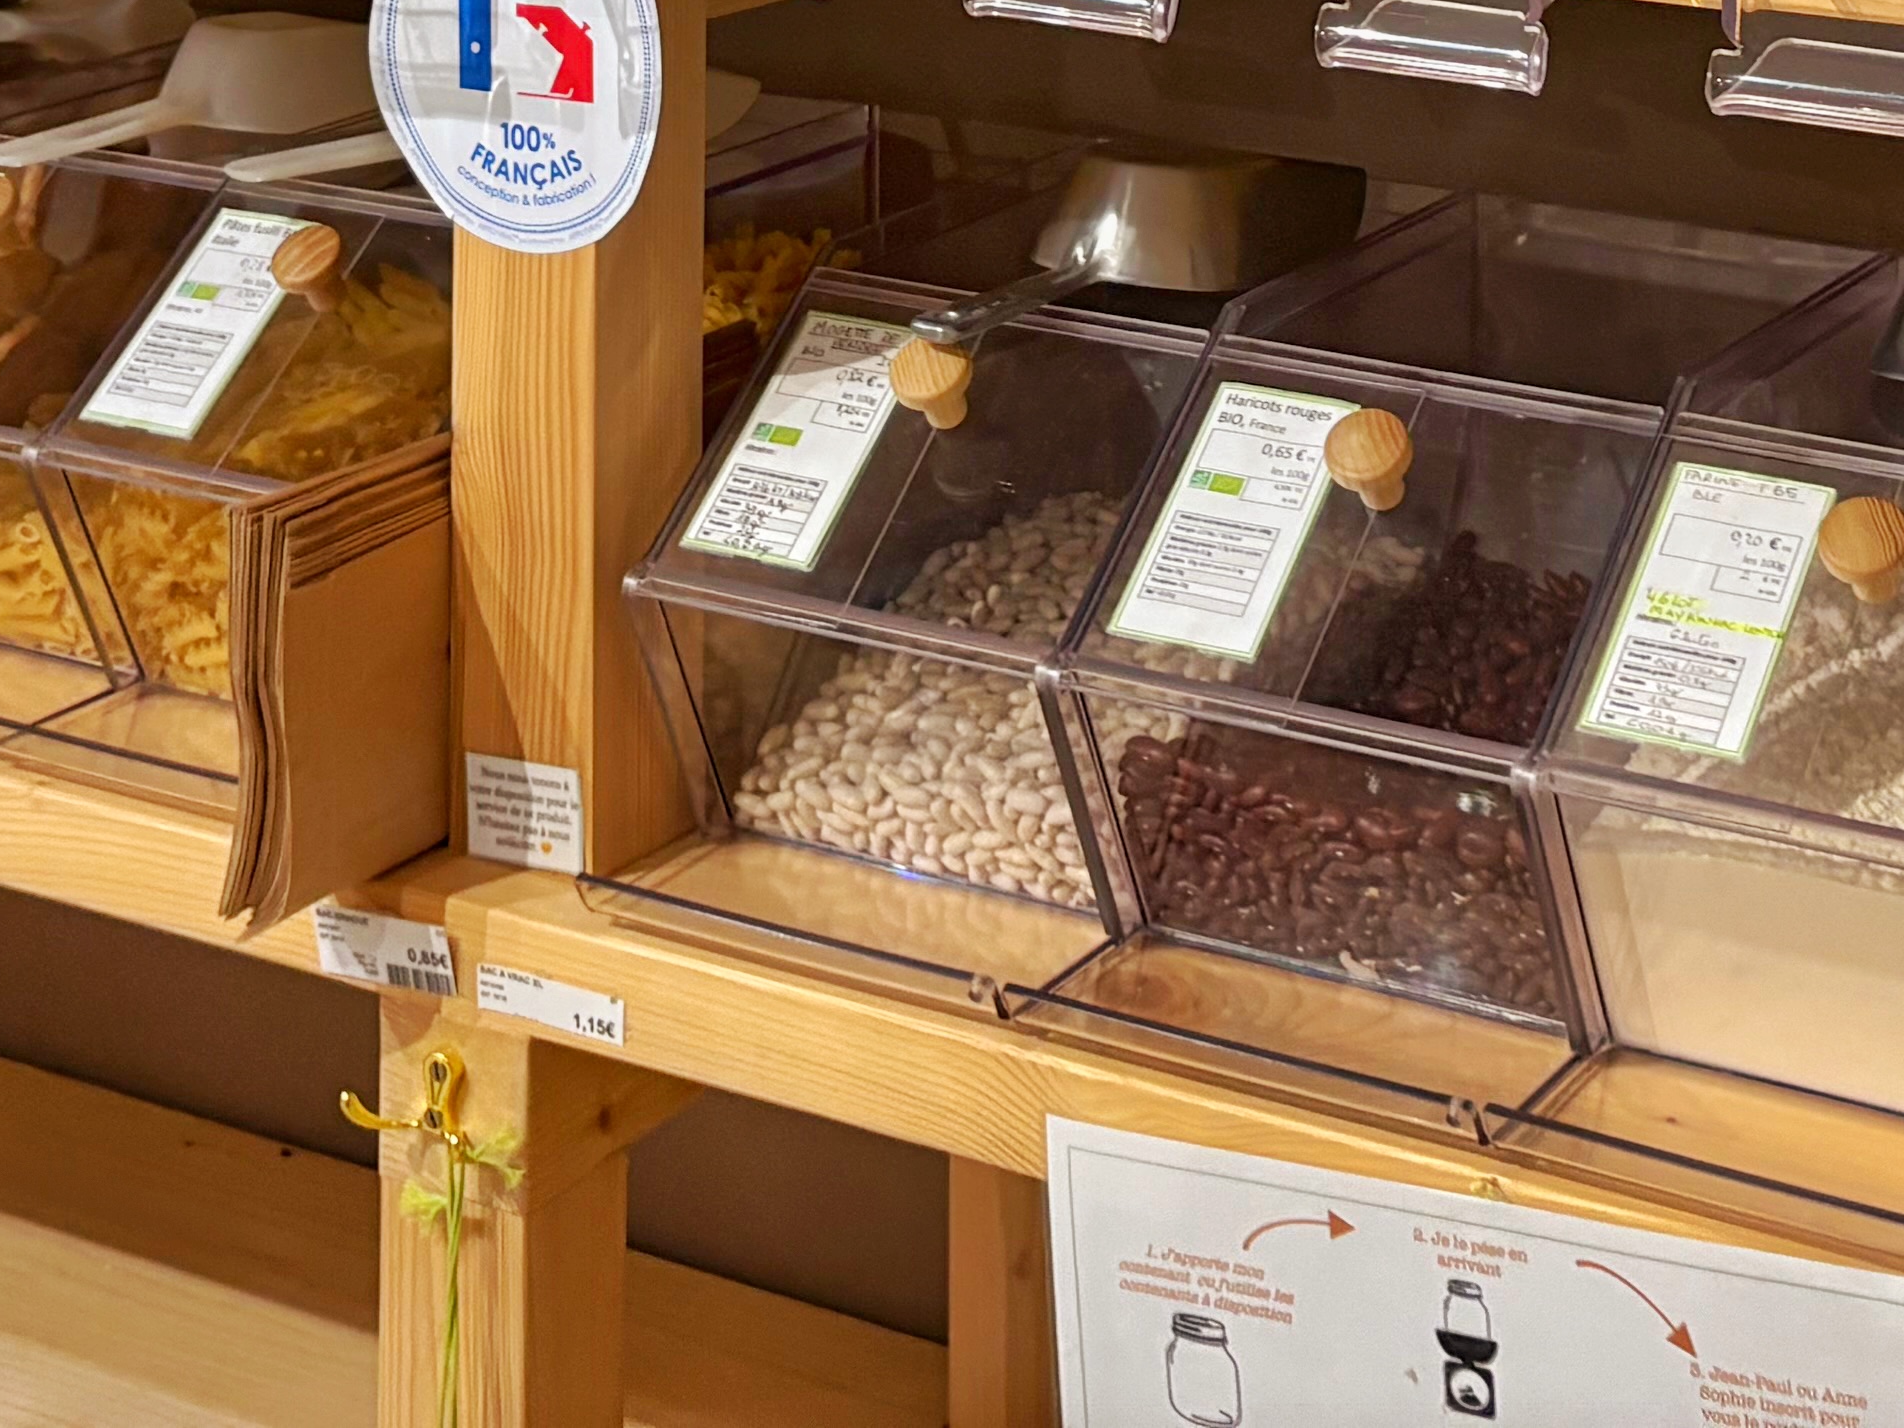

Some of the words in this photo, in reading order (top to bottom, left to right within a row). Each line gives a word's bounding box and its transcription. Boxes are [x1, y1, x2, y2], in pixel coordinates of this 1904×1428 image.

[500, 122, 556, 152] 100%
[470, 142, 582, 190] FRANÇAIS
[457, 165, 519, 204] conception
[533, 179, 592, 207] fabrication
[1217, 412, 1244, 427] BIO,
[1226, 394, 1282, 413] Haricots
[1284, 405, 1332, 422] rouges
[1261, 444, 1294, 459] 0,65
[1437, 1254, 1501, 1278] arrivant
[1700, 1385, 1756, 1410] Sophie
[1708, 1365, 1793, 1396] Jean-Paul
[1822, 1387, 1868, 1410] Anne
